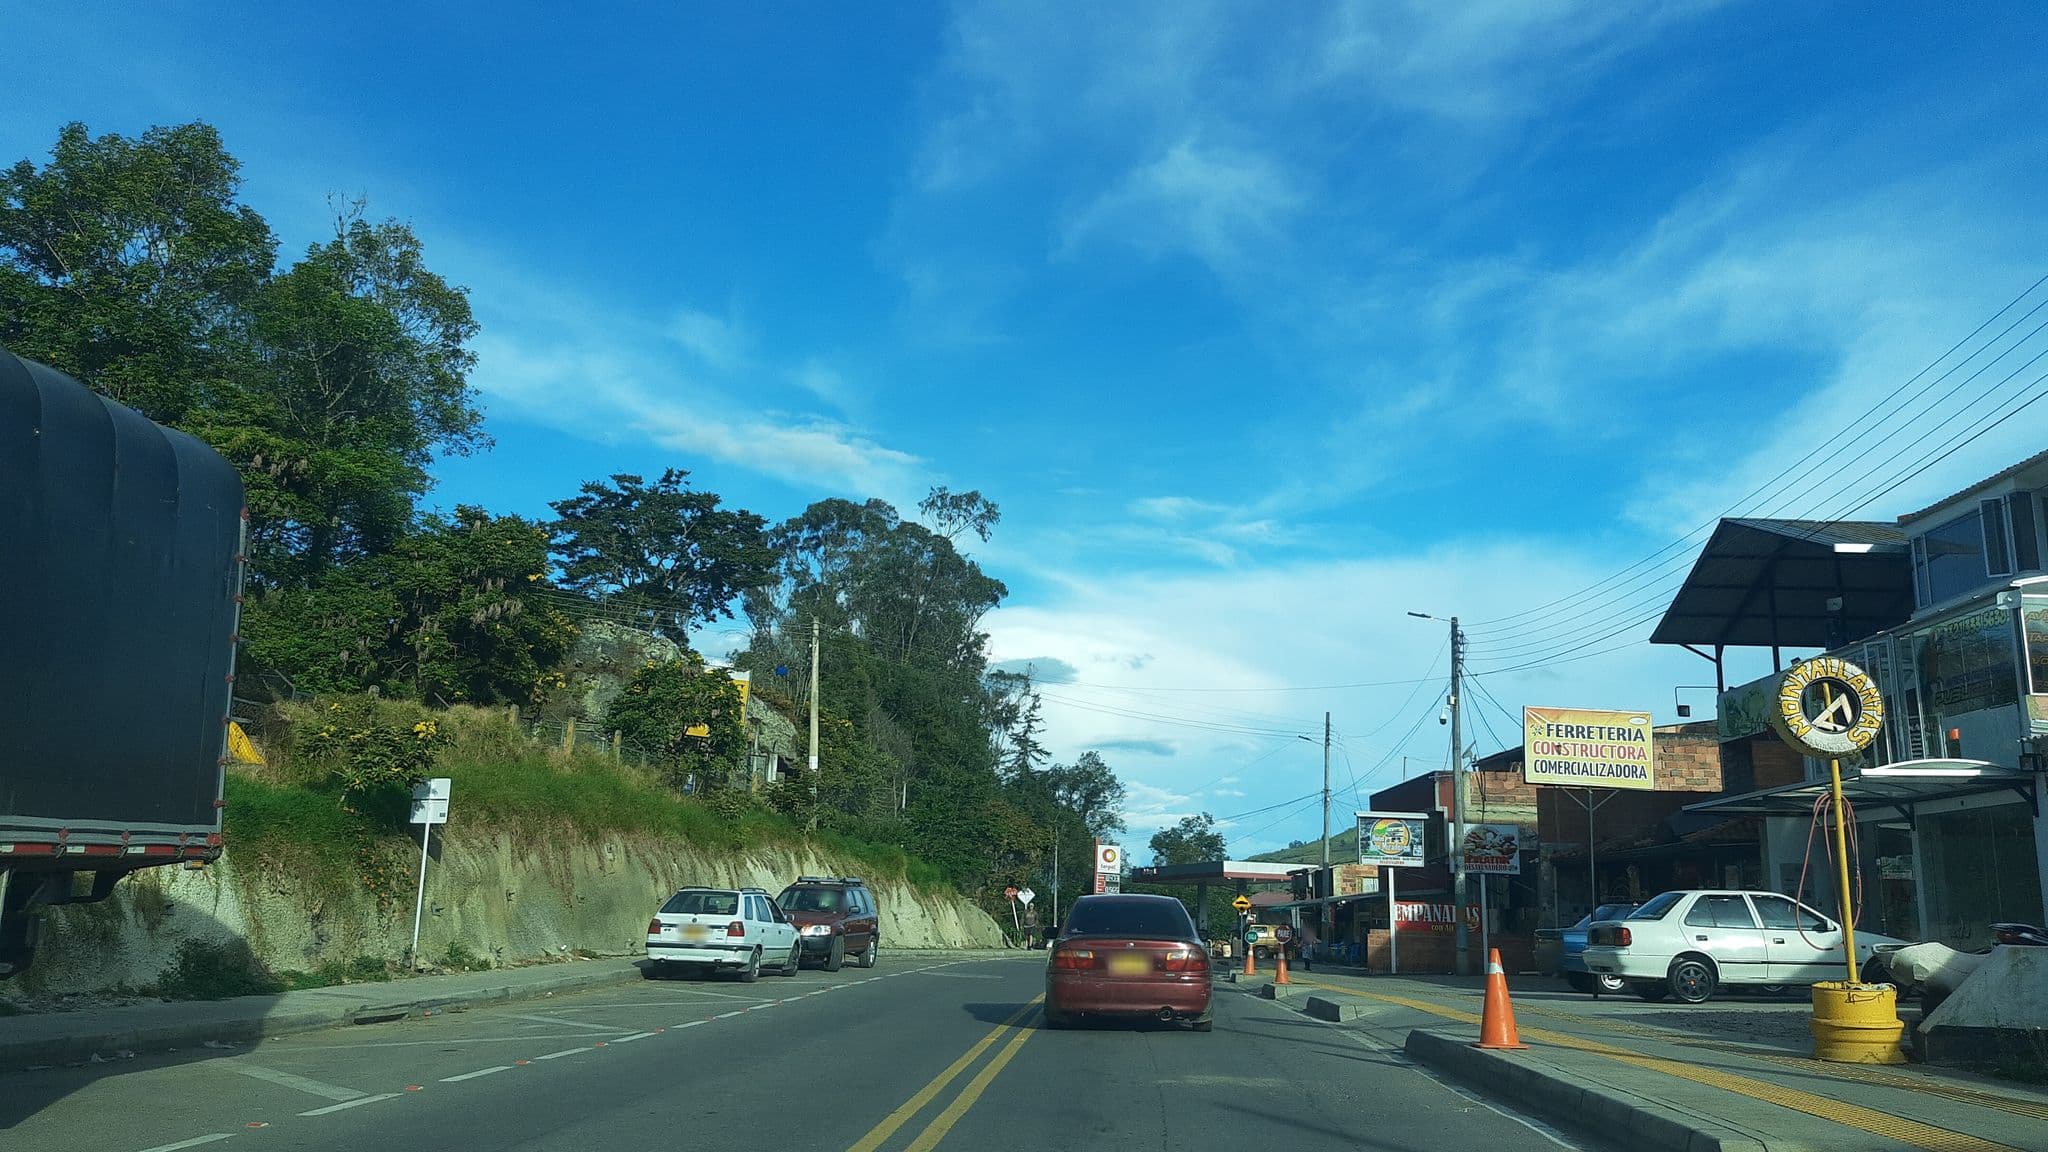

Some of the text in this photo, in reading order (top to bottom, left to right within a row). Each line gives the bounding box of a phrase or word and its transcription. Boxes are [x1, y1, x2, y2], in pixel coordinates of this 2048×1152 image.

[1781, 656, 1884, 751] MONTALLANTAS
[1546, 723, 1645, 742] FERRETERIA
[1533, 740, 1647, 760] CONSTRUCTORA
[1534, 759, 1647, 779] COMERCIALIZADORA
